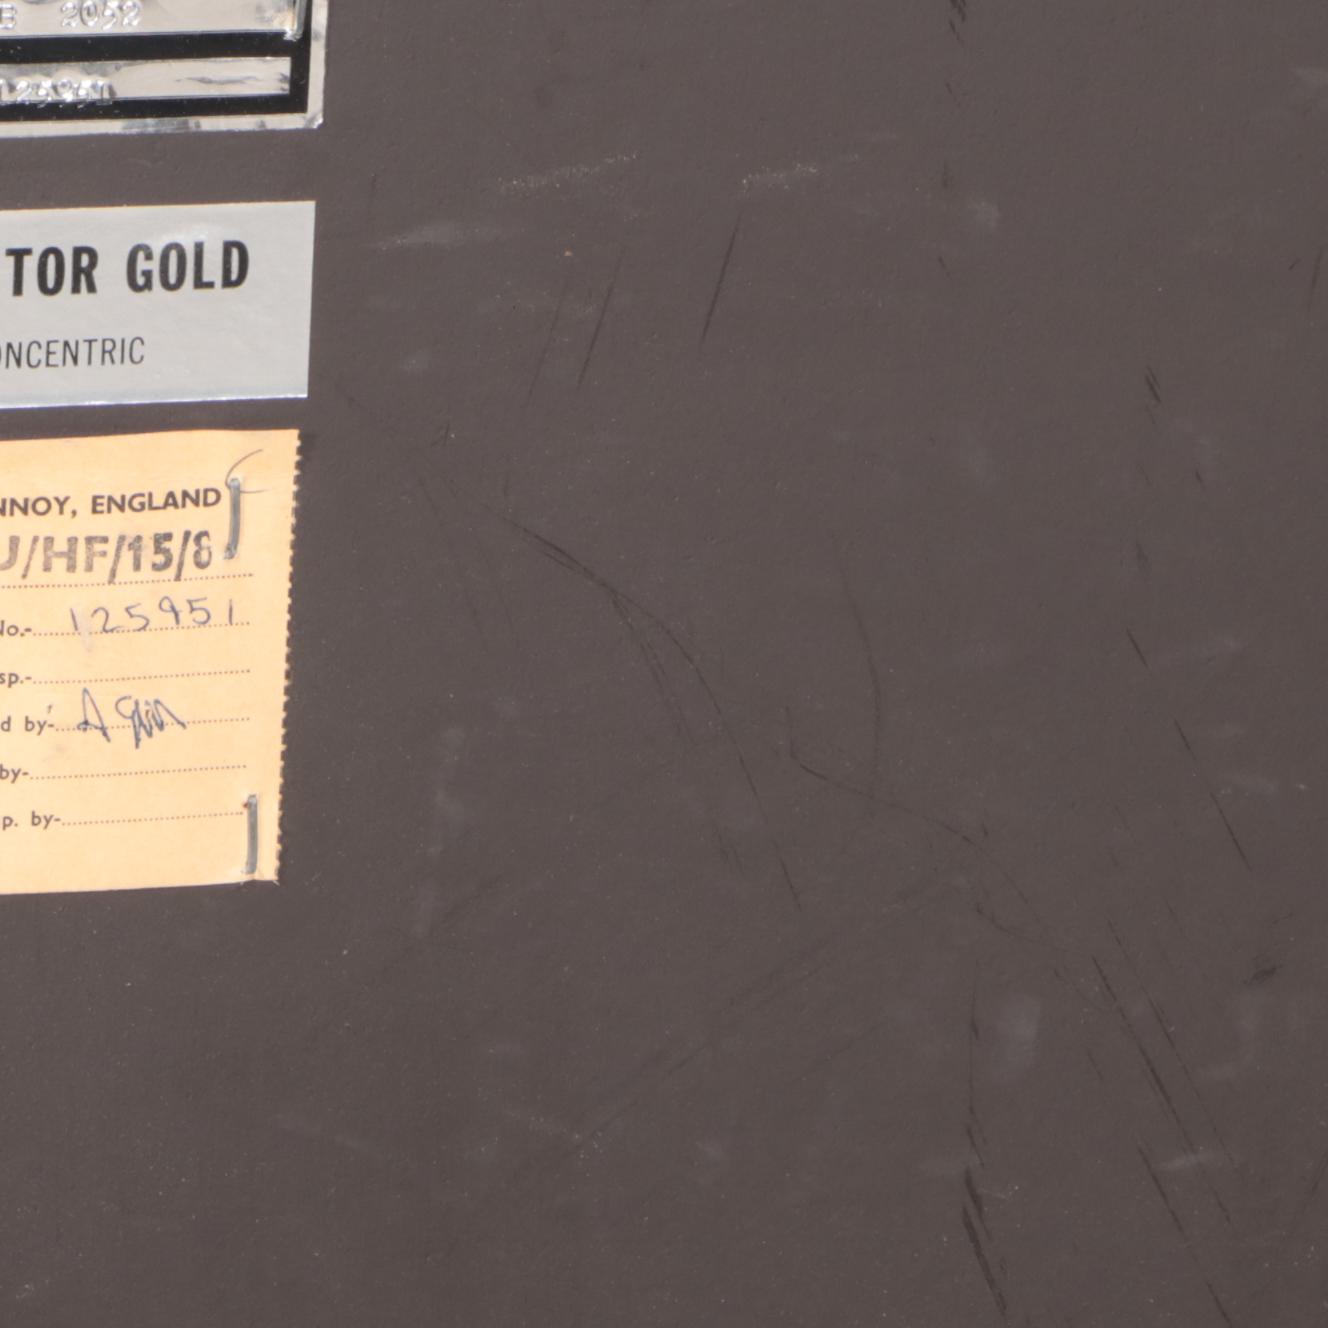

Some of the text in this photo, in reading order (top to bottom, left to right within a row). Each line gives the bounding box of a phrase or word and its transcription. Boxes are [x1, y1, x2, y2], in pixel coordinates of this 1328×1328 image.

[126, 239, 250, 294] GOLD
[91, 487, 221, 515] ENGLAND
[69, 596, 234, 634] 125951
